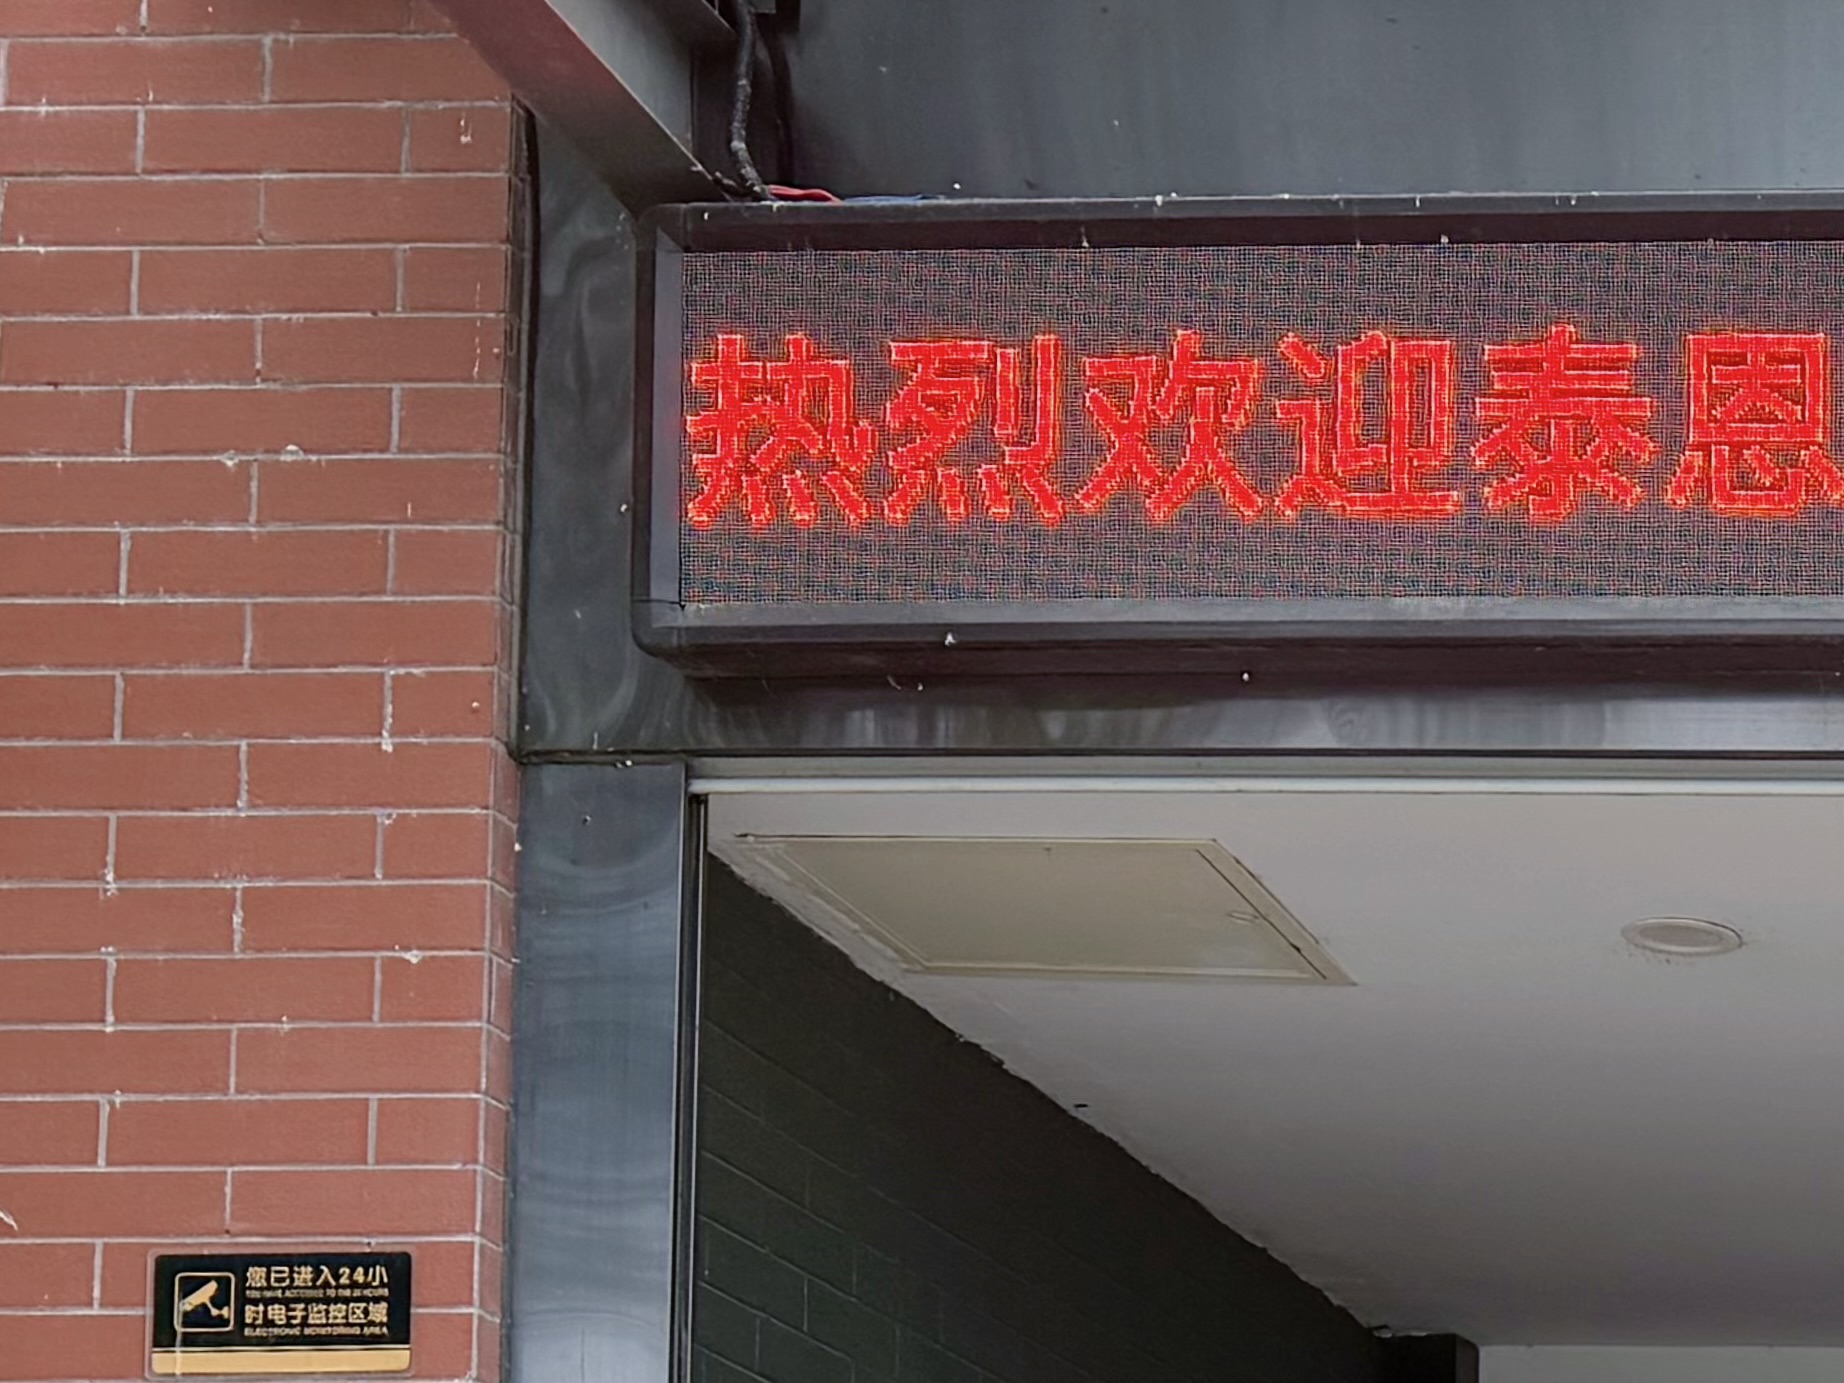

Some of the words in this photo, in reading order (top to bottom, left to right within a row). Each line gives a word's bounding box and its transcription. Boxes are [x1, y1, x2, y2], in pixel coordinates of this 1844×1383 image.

[244, 1302, 389, 1325] 时电子监控区域
